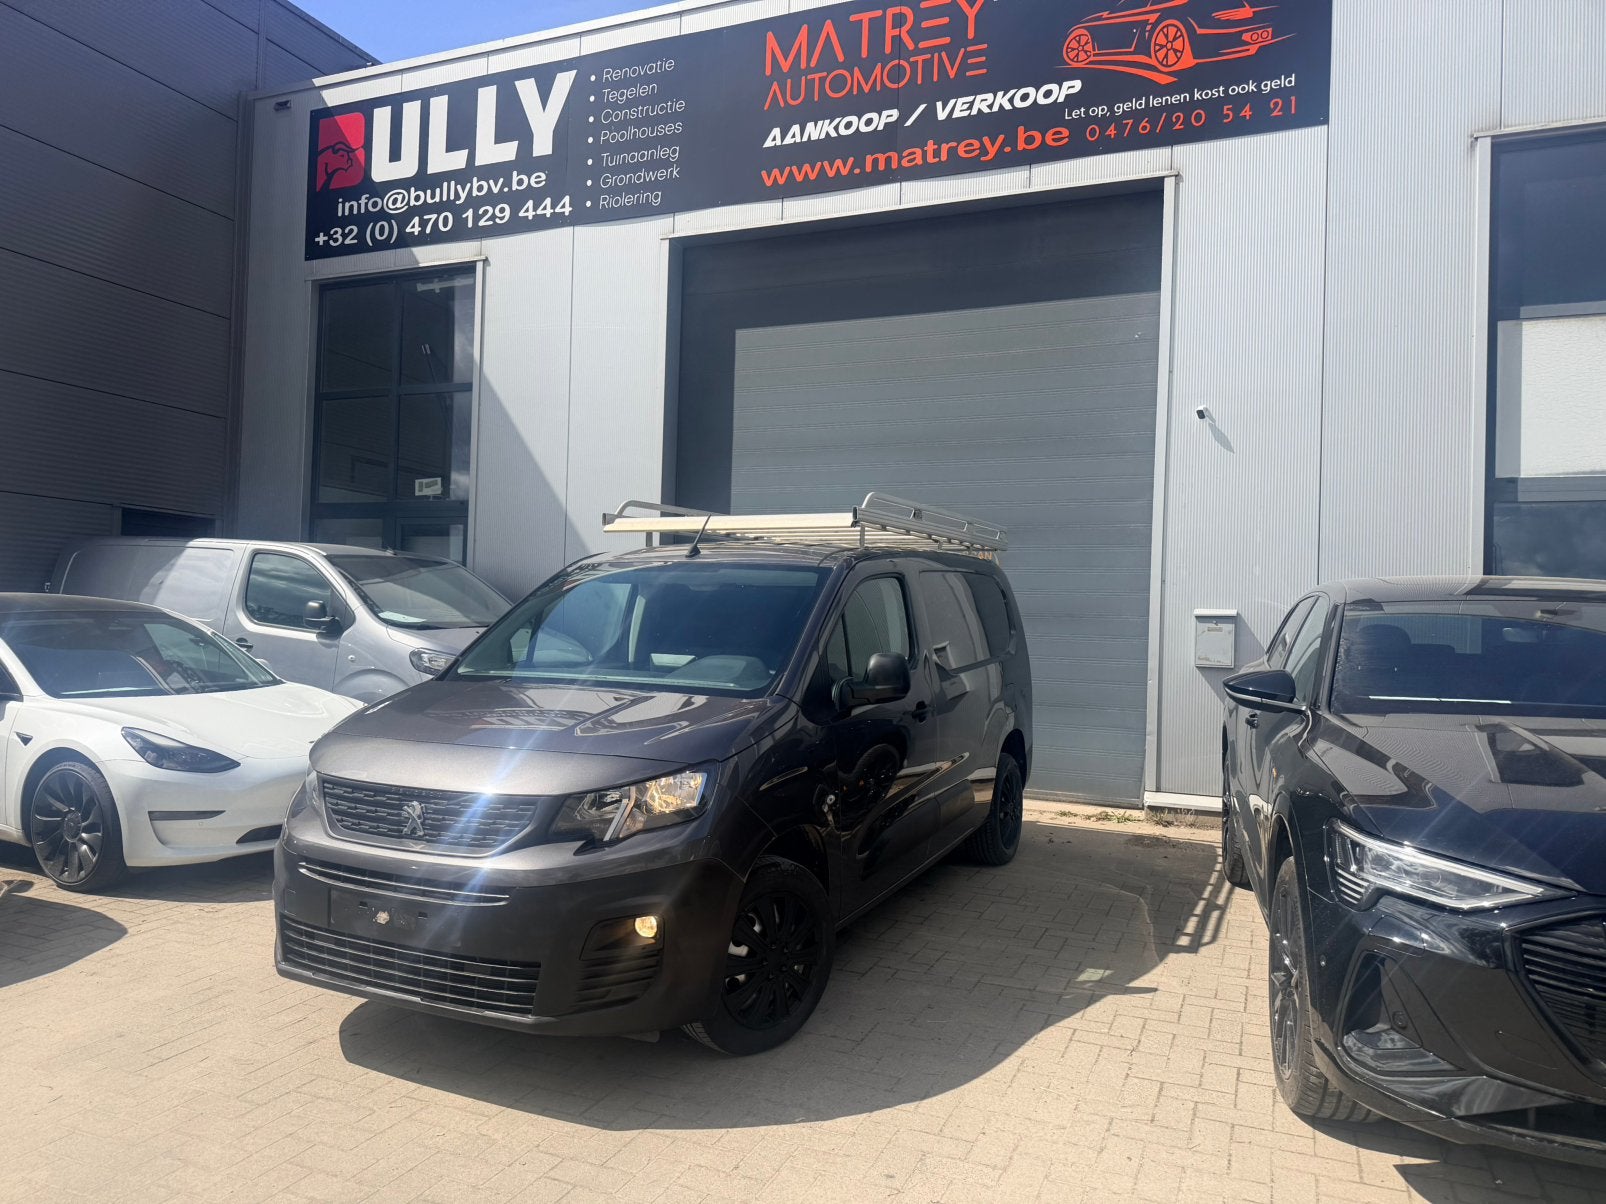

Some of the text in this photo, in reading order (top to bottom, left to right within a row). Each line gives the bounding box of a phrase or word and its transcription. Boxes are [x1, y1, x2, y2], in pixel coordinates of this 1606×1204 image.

[765, 0, 985, 76] MATREY
[602, 57, 675, 82] Renovatie
[602, 81, 658, 104] Tegelen
[764, 43, 988, 110] AUTOMOTIVE
[600, 98, 686, 124] Constructie
[763, 79, 1082, 148] AANKOOP / VERKOOP
[1064, 73, 1296, 120] Let op, geld lenen kost ook geld
[1086, 95, 1297, 142] 0476/20 54 21
[600, 121, 683, 144] Poolhouses
[761, 125, 1070, 187] www.matrey.be
[600, 164, 681, 189] Grondwerk
[601, 145, 680, 168] Tuinaanleg
[337, 170, 547, 217] info@bullybv.be
[599, 189, 662, 210] Riolering
[314, 195, 573, 248] +32 (0) 470 129 444
